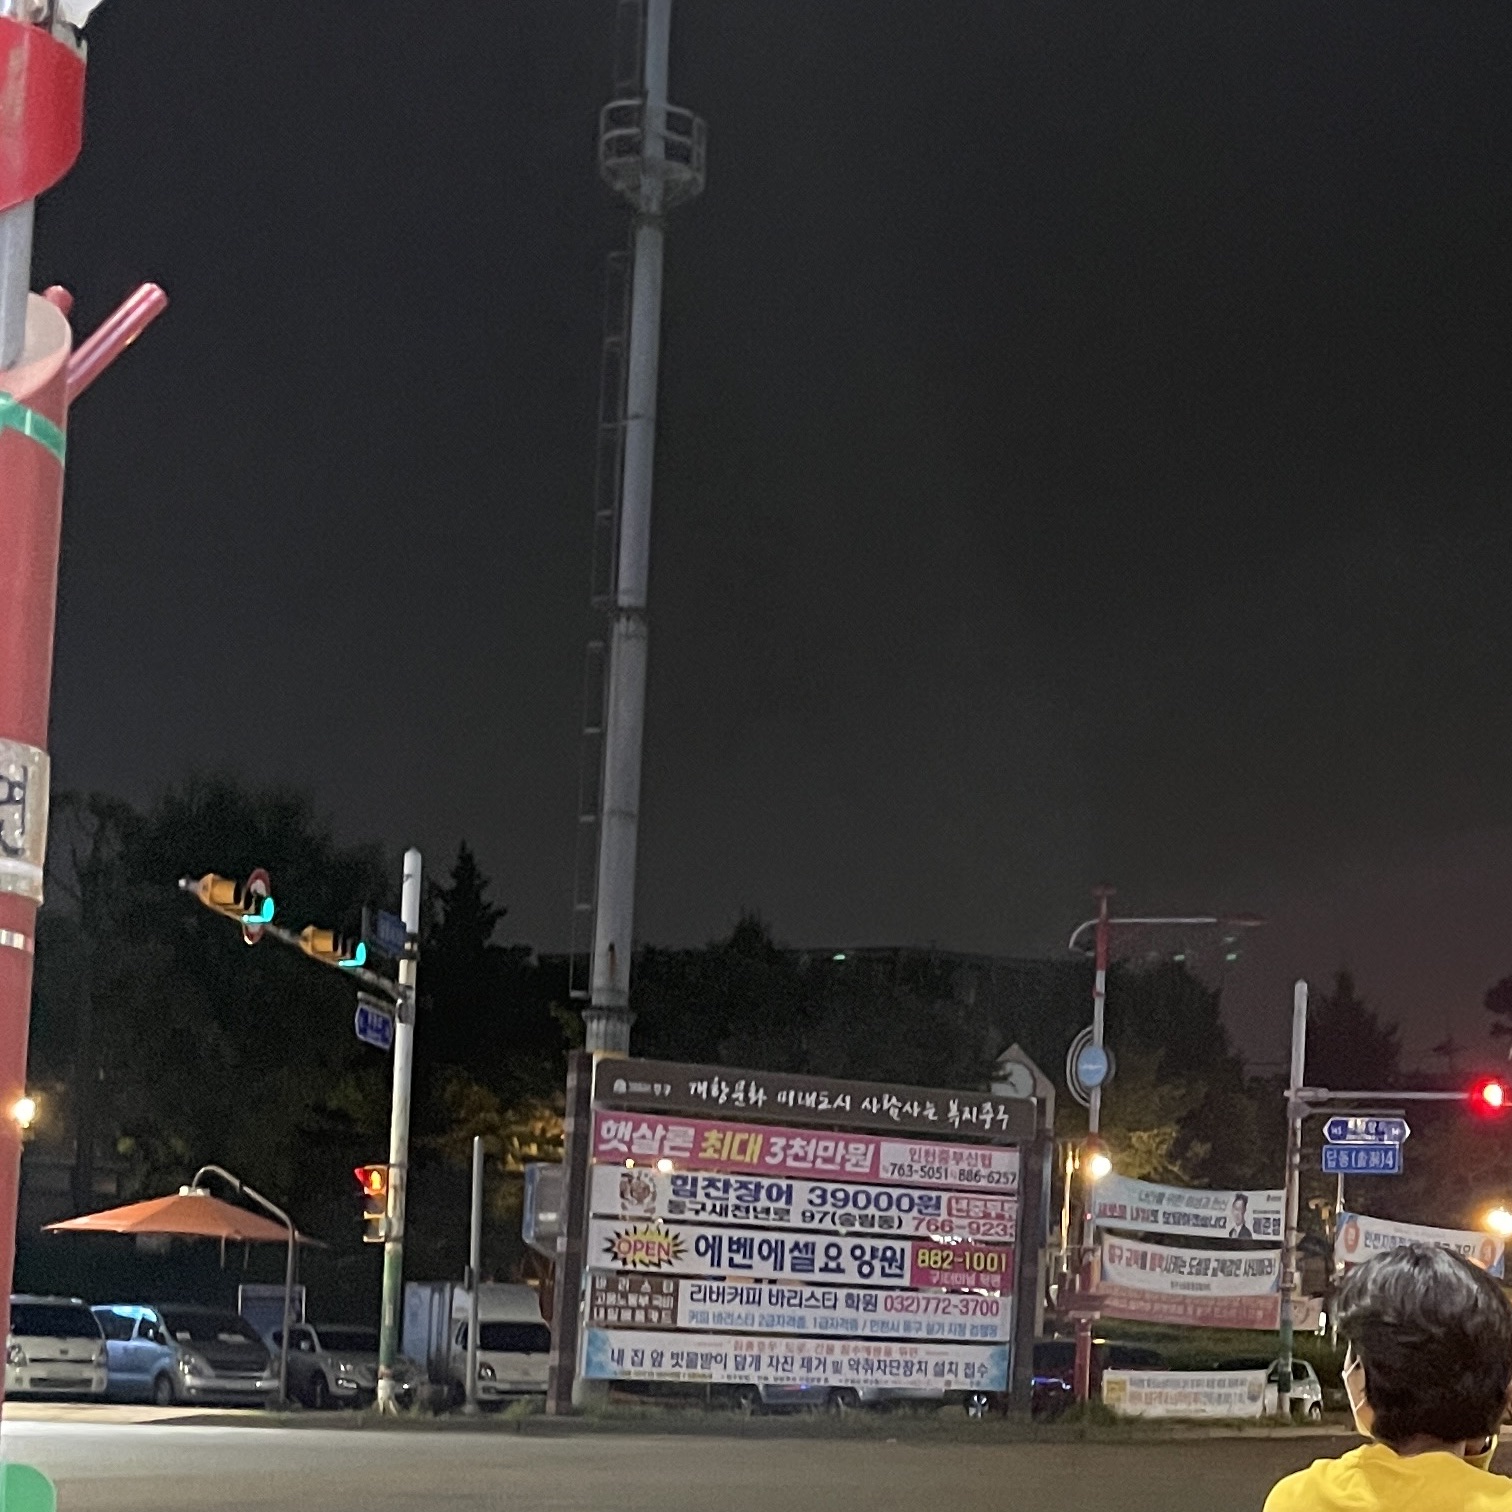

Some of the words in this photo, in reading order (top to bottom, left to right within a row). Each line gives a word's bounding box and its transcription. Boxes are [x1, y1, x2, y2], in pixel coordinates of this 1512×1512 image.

[599, 1119, 695, 1157] 햇살론
[698, 1128, 763, 1165] 최대
[765, 1136, 875, 1173] 3천만원
[889, 1162, 949, 1181] 763-5051
[807, 1185, 942, 1217] 39000원
[911, 1216, 1014, 1237] 766-923
[616, 1238, 672, 1258] OPEN
[917, 1248, 1007, 1273] 882-1001
[689, 1284, 762, 1307] 리버커피
[768, 1286, 838, 1311] 바리스타
[884, 1294, 1000, 1317] 032)772-3700
[610, 1348, 624, 1367] 내
